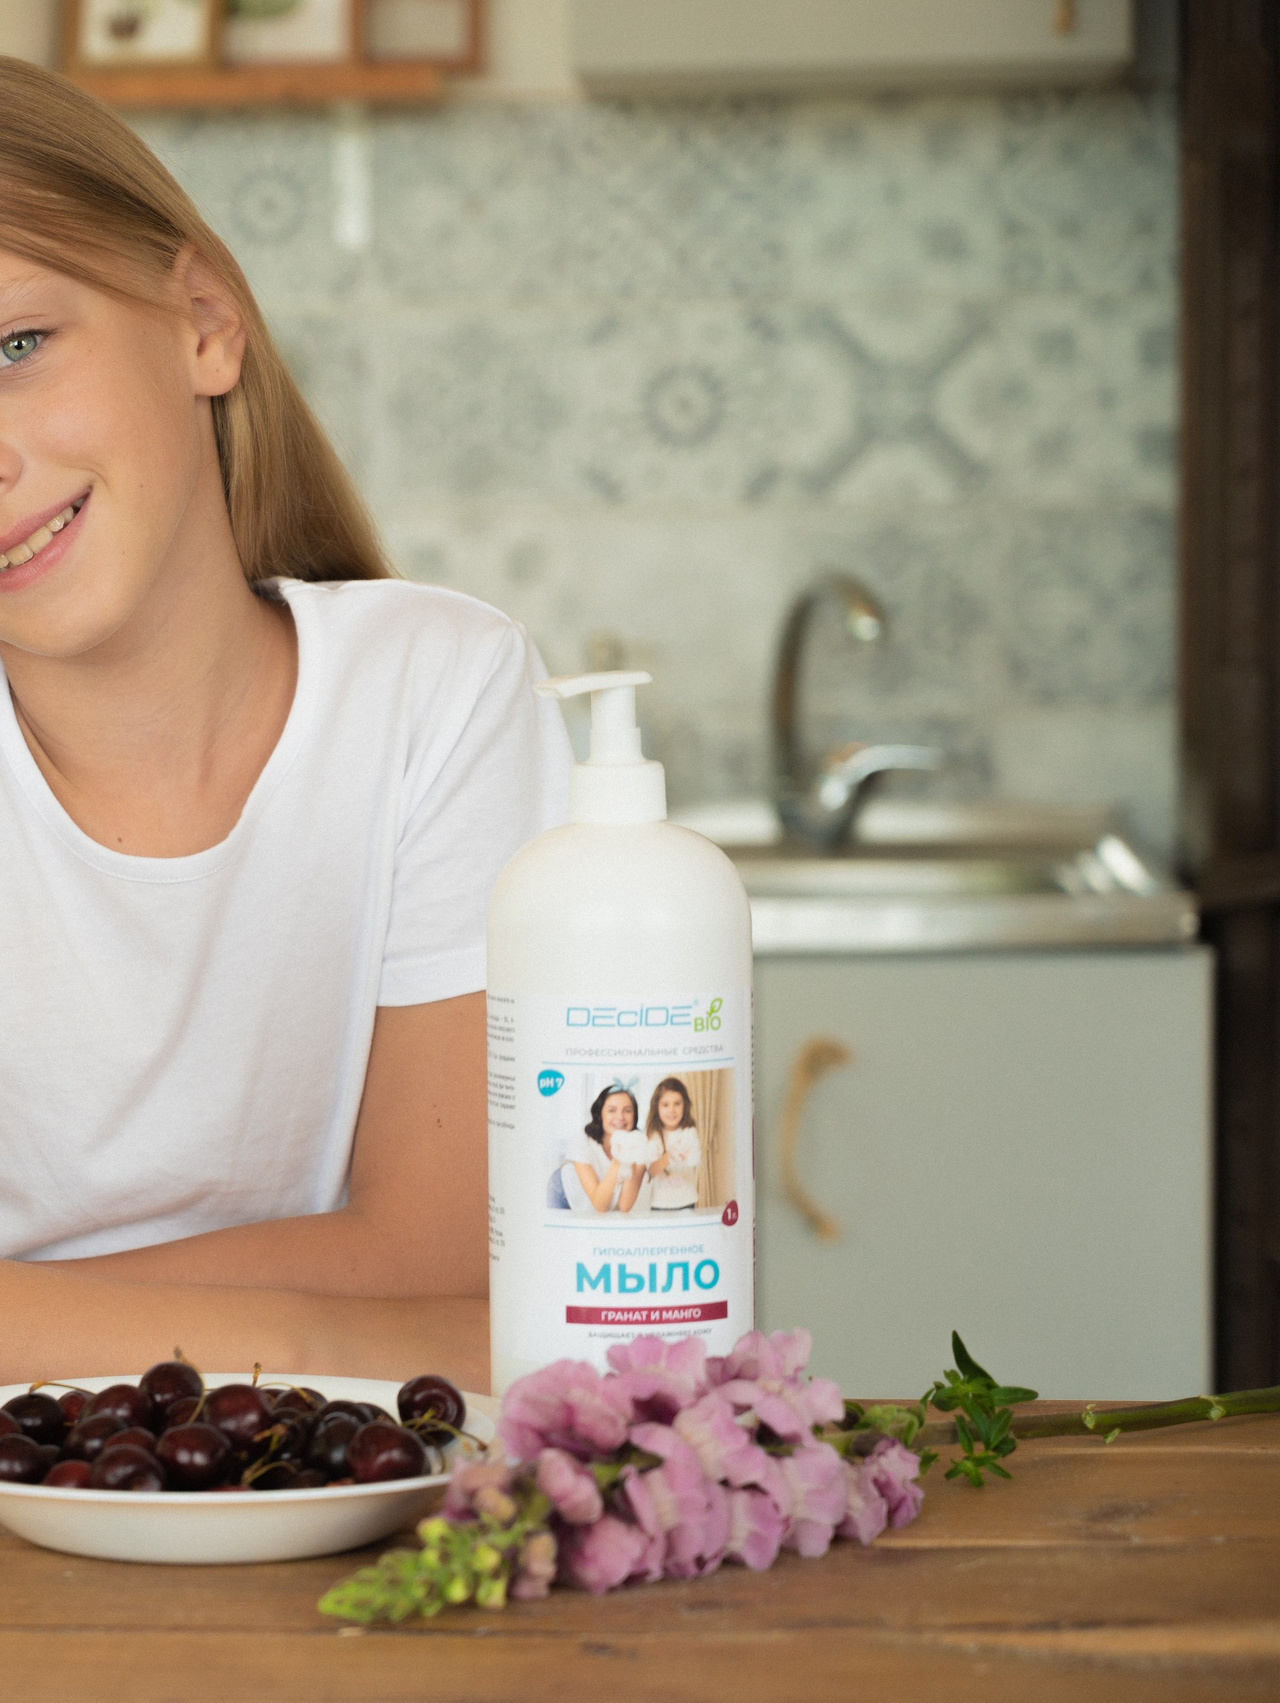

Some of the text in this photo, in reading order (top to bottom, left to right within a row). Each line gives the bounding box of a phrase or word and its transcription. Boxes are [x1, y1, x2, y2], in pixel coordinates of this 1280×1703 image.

[694, 1015, 721, 1032] BIO
[565, 1044, 724, 1057] ПРОФЕССИОНАЛЬНЫЕ СРЕДСТВА
[556, 1077, 563, 1088] 7
[593, 1244, 704, 1256] ГИПОАЛЛЕРГЕННОЕ
[576, 1259, 720, 1293] МЫЛО
[601, 1307, 702, 1322] ГРАНАТ И МАНГО
